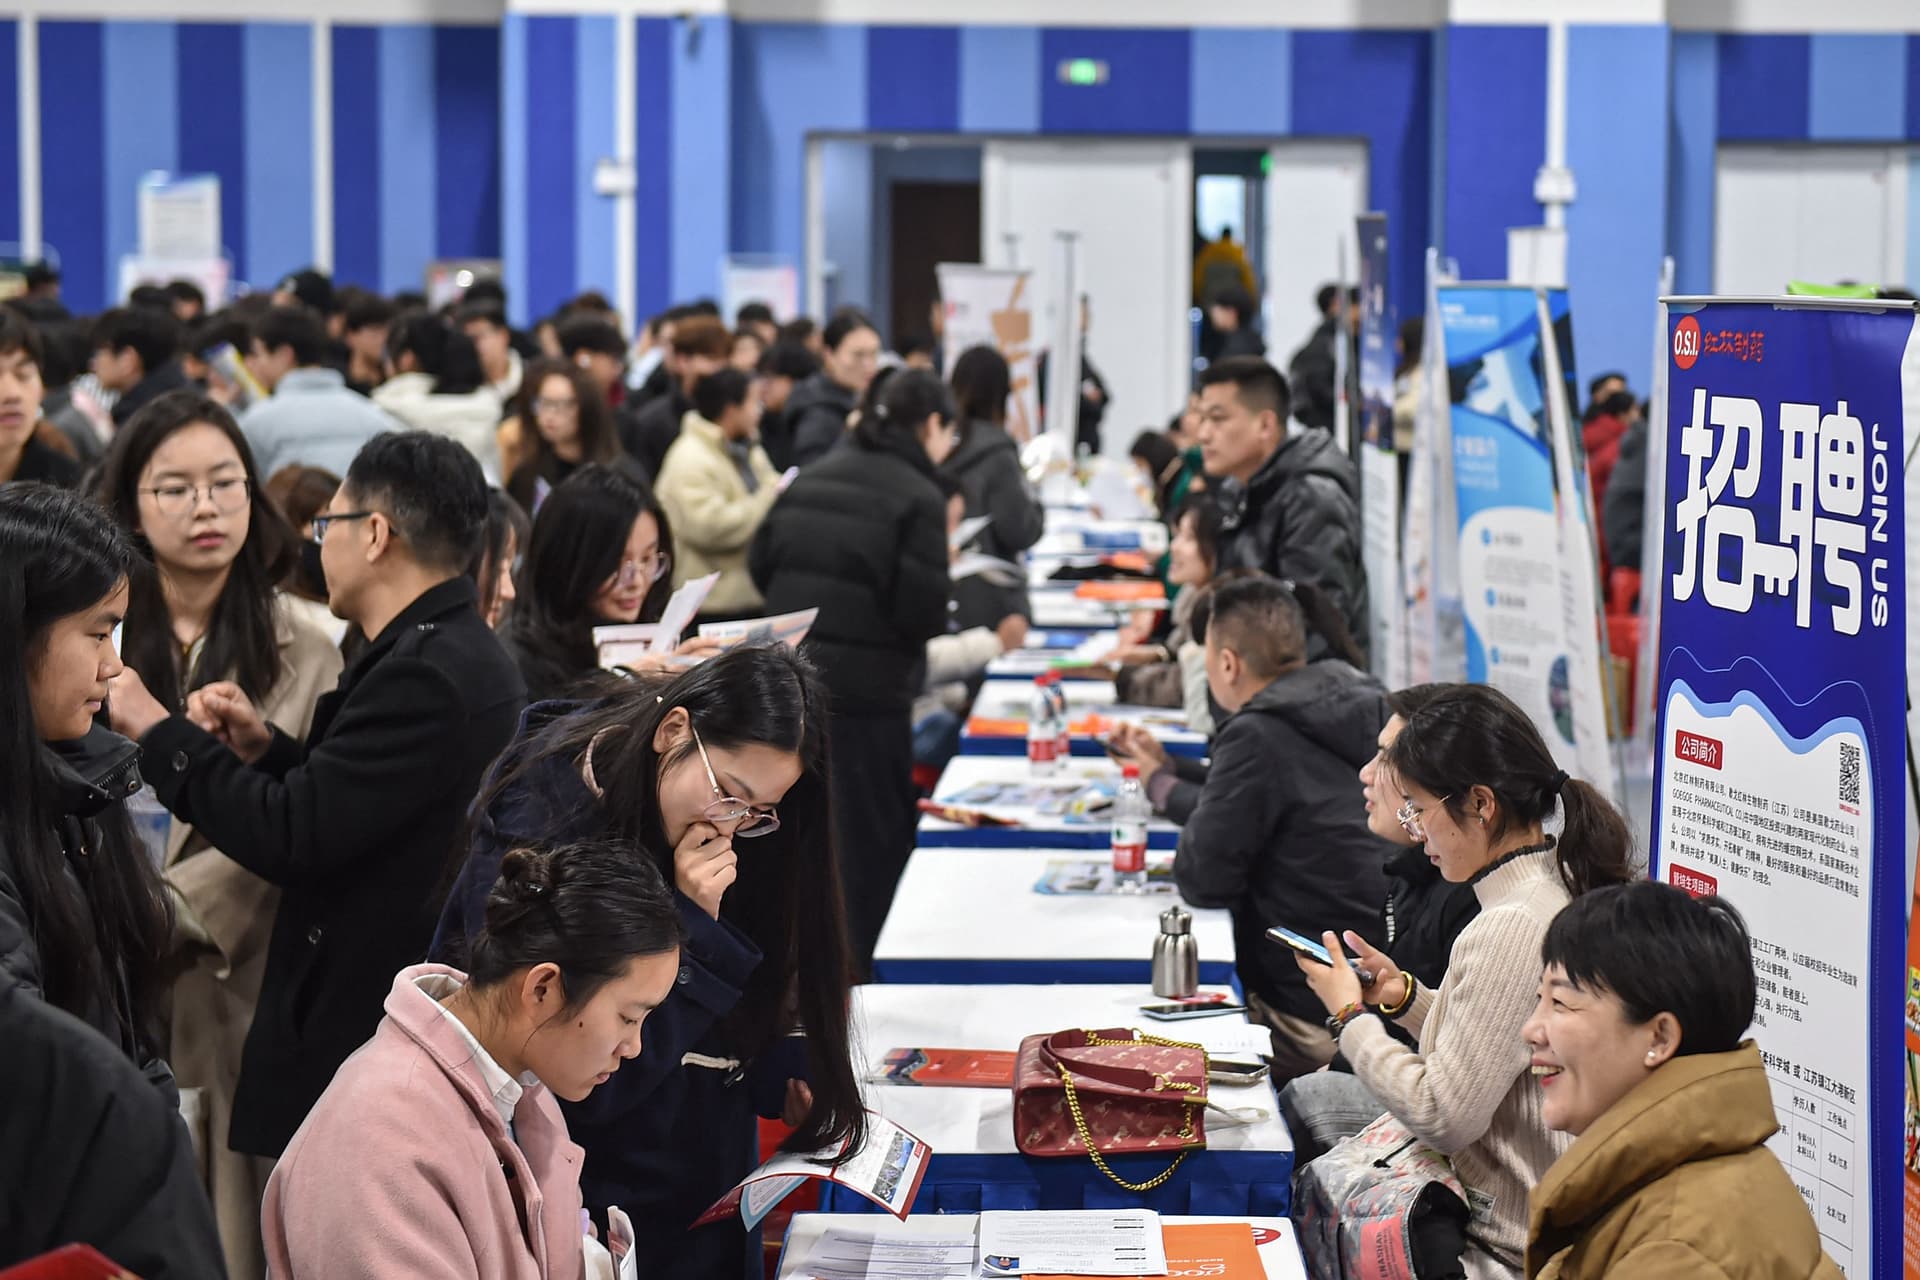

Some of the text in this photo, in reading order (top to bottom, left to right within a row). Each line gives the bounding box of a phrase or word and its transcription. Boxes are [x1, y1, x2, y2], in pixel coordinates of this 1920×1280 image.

[1673, 388, 1867, 636] 招聘
[1871, 422, 1889, 627] JOIN US
[1681, 735, 1718, 765] 公司简介
[1803, 1067, 1856, 1105] 江苏镇江大港新区
